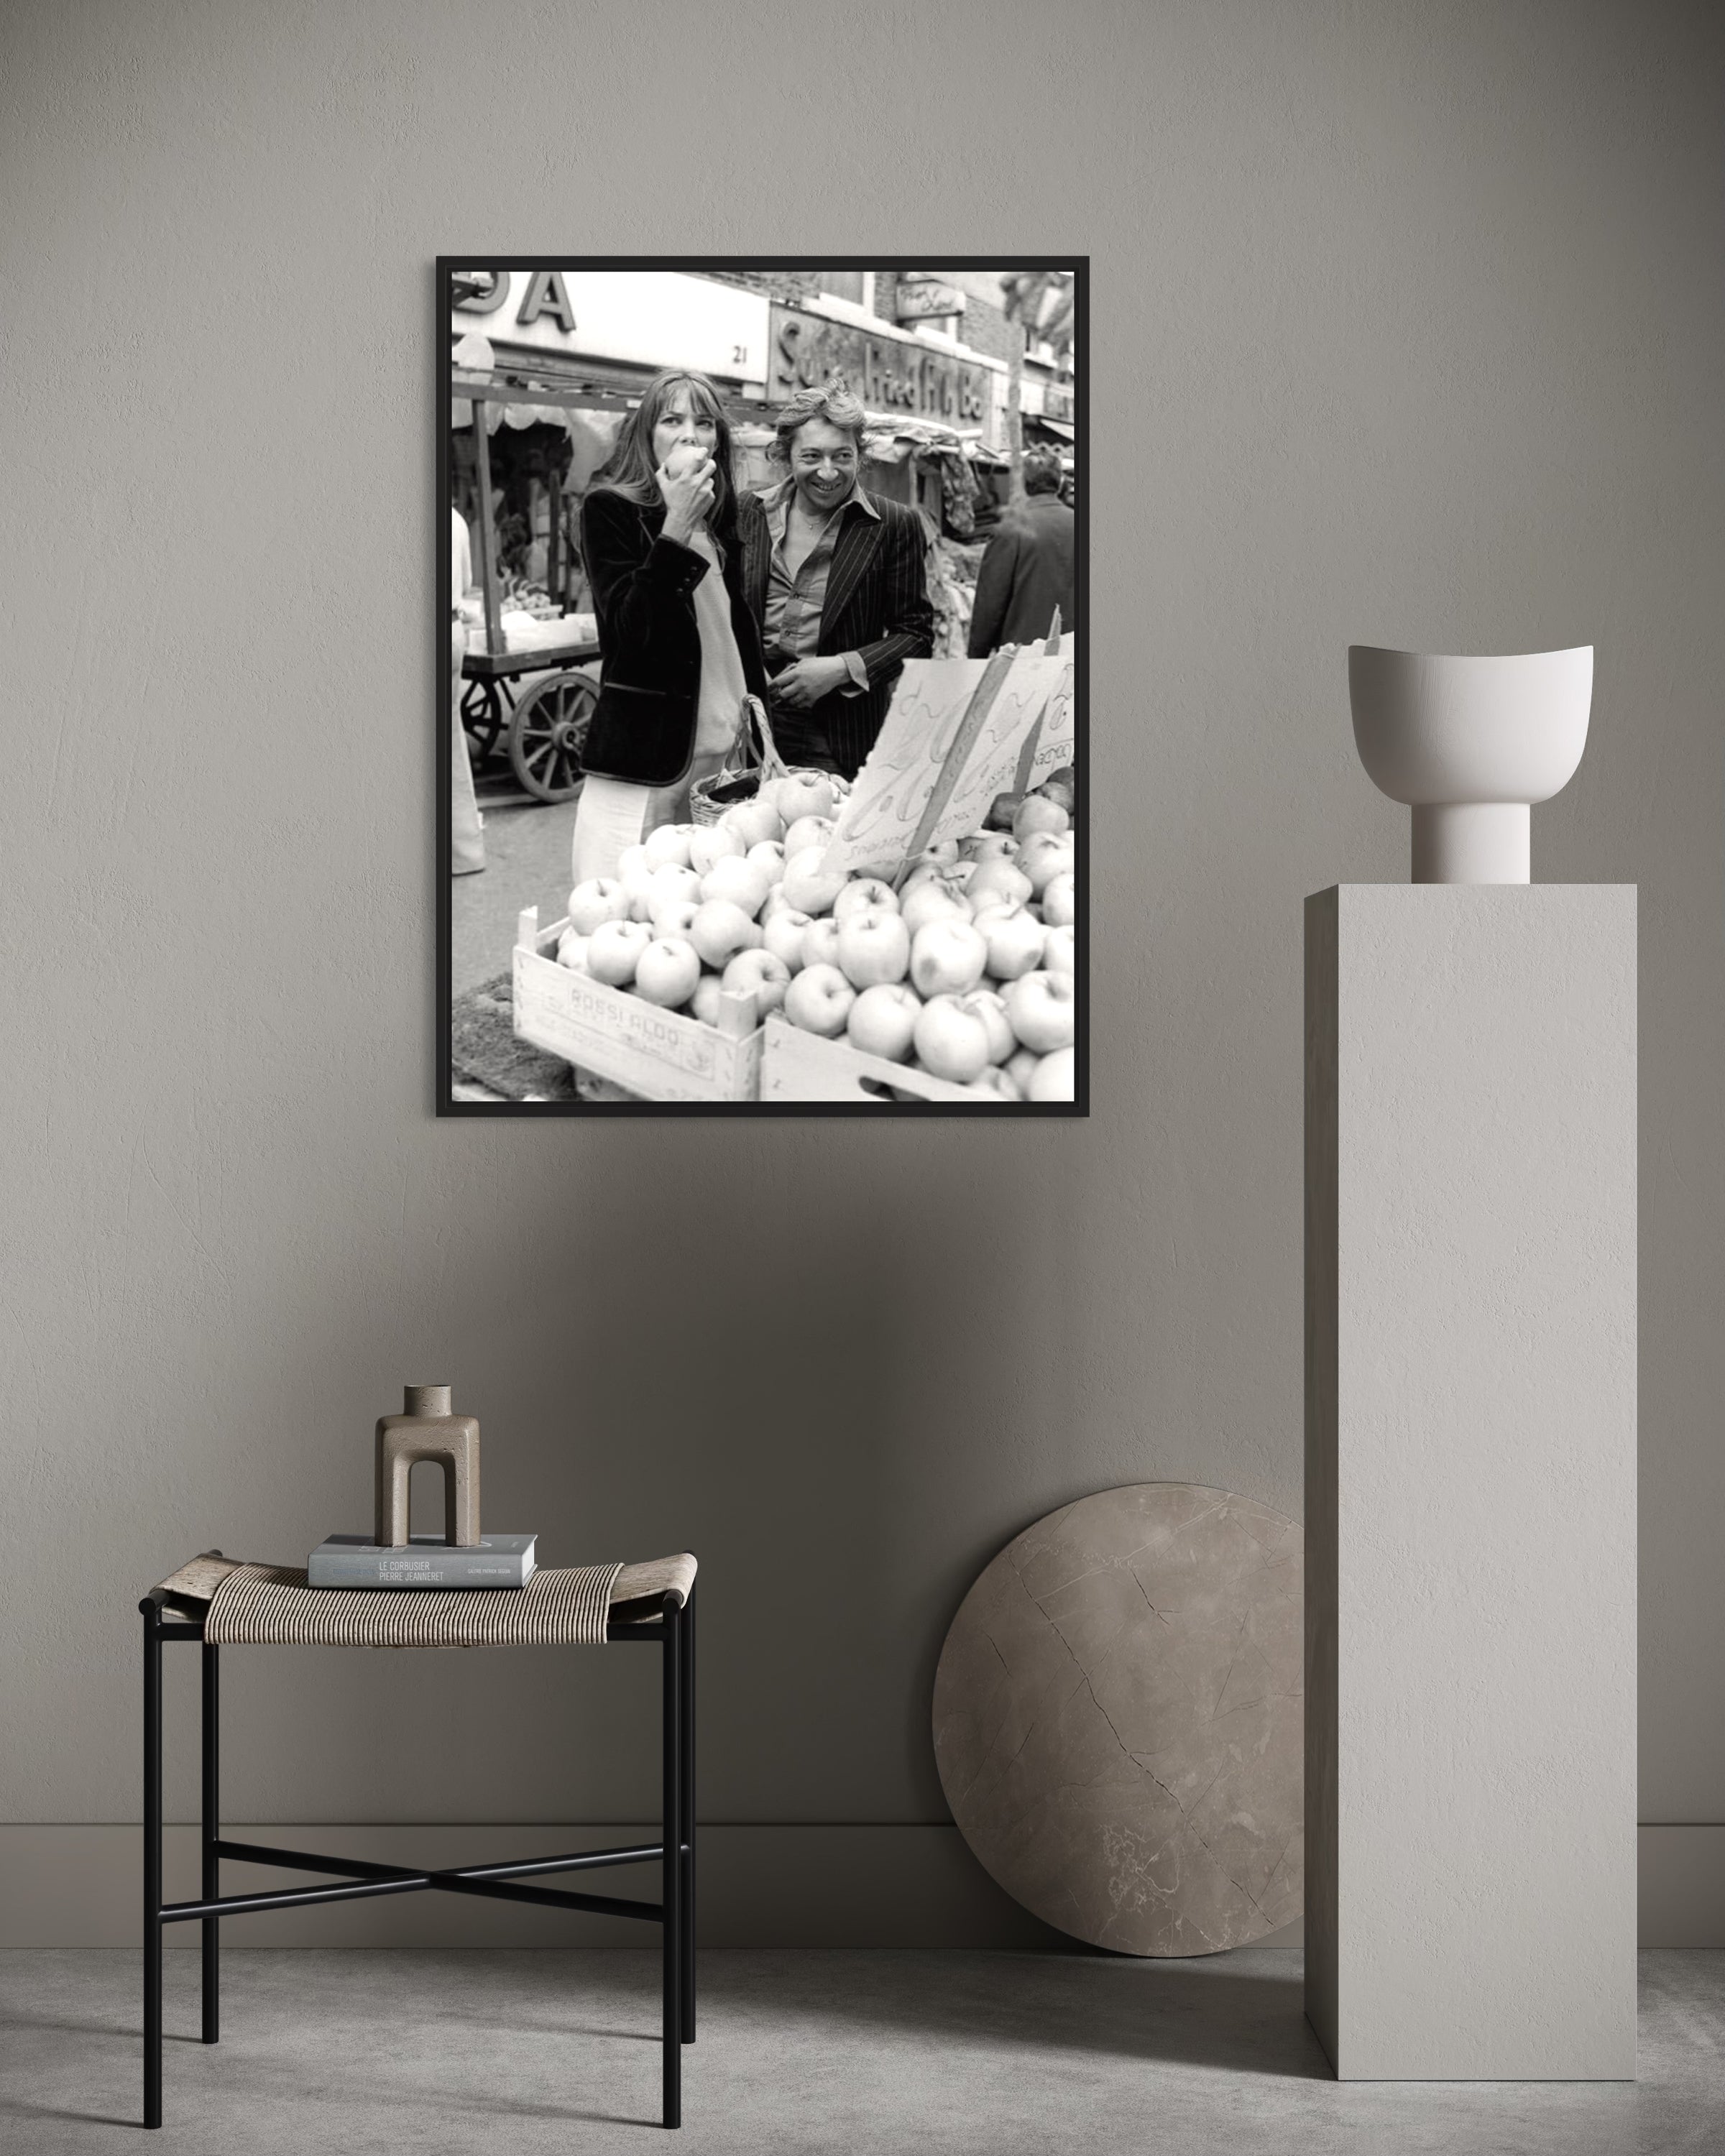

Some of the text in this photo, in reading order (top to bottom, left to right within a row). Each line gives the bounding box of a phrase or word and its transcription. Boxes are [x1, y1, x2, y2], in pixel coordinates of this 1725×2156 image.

[733, 346, 747, 364] 21
[380, 1562, 430, 1570] LE CORBUSIER
